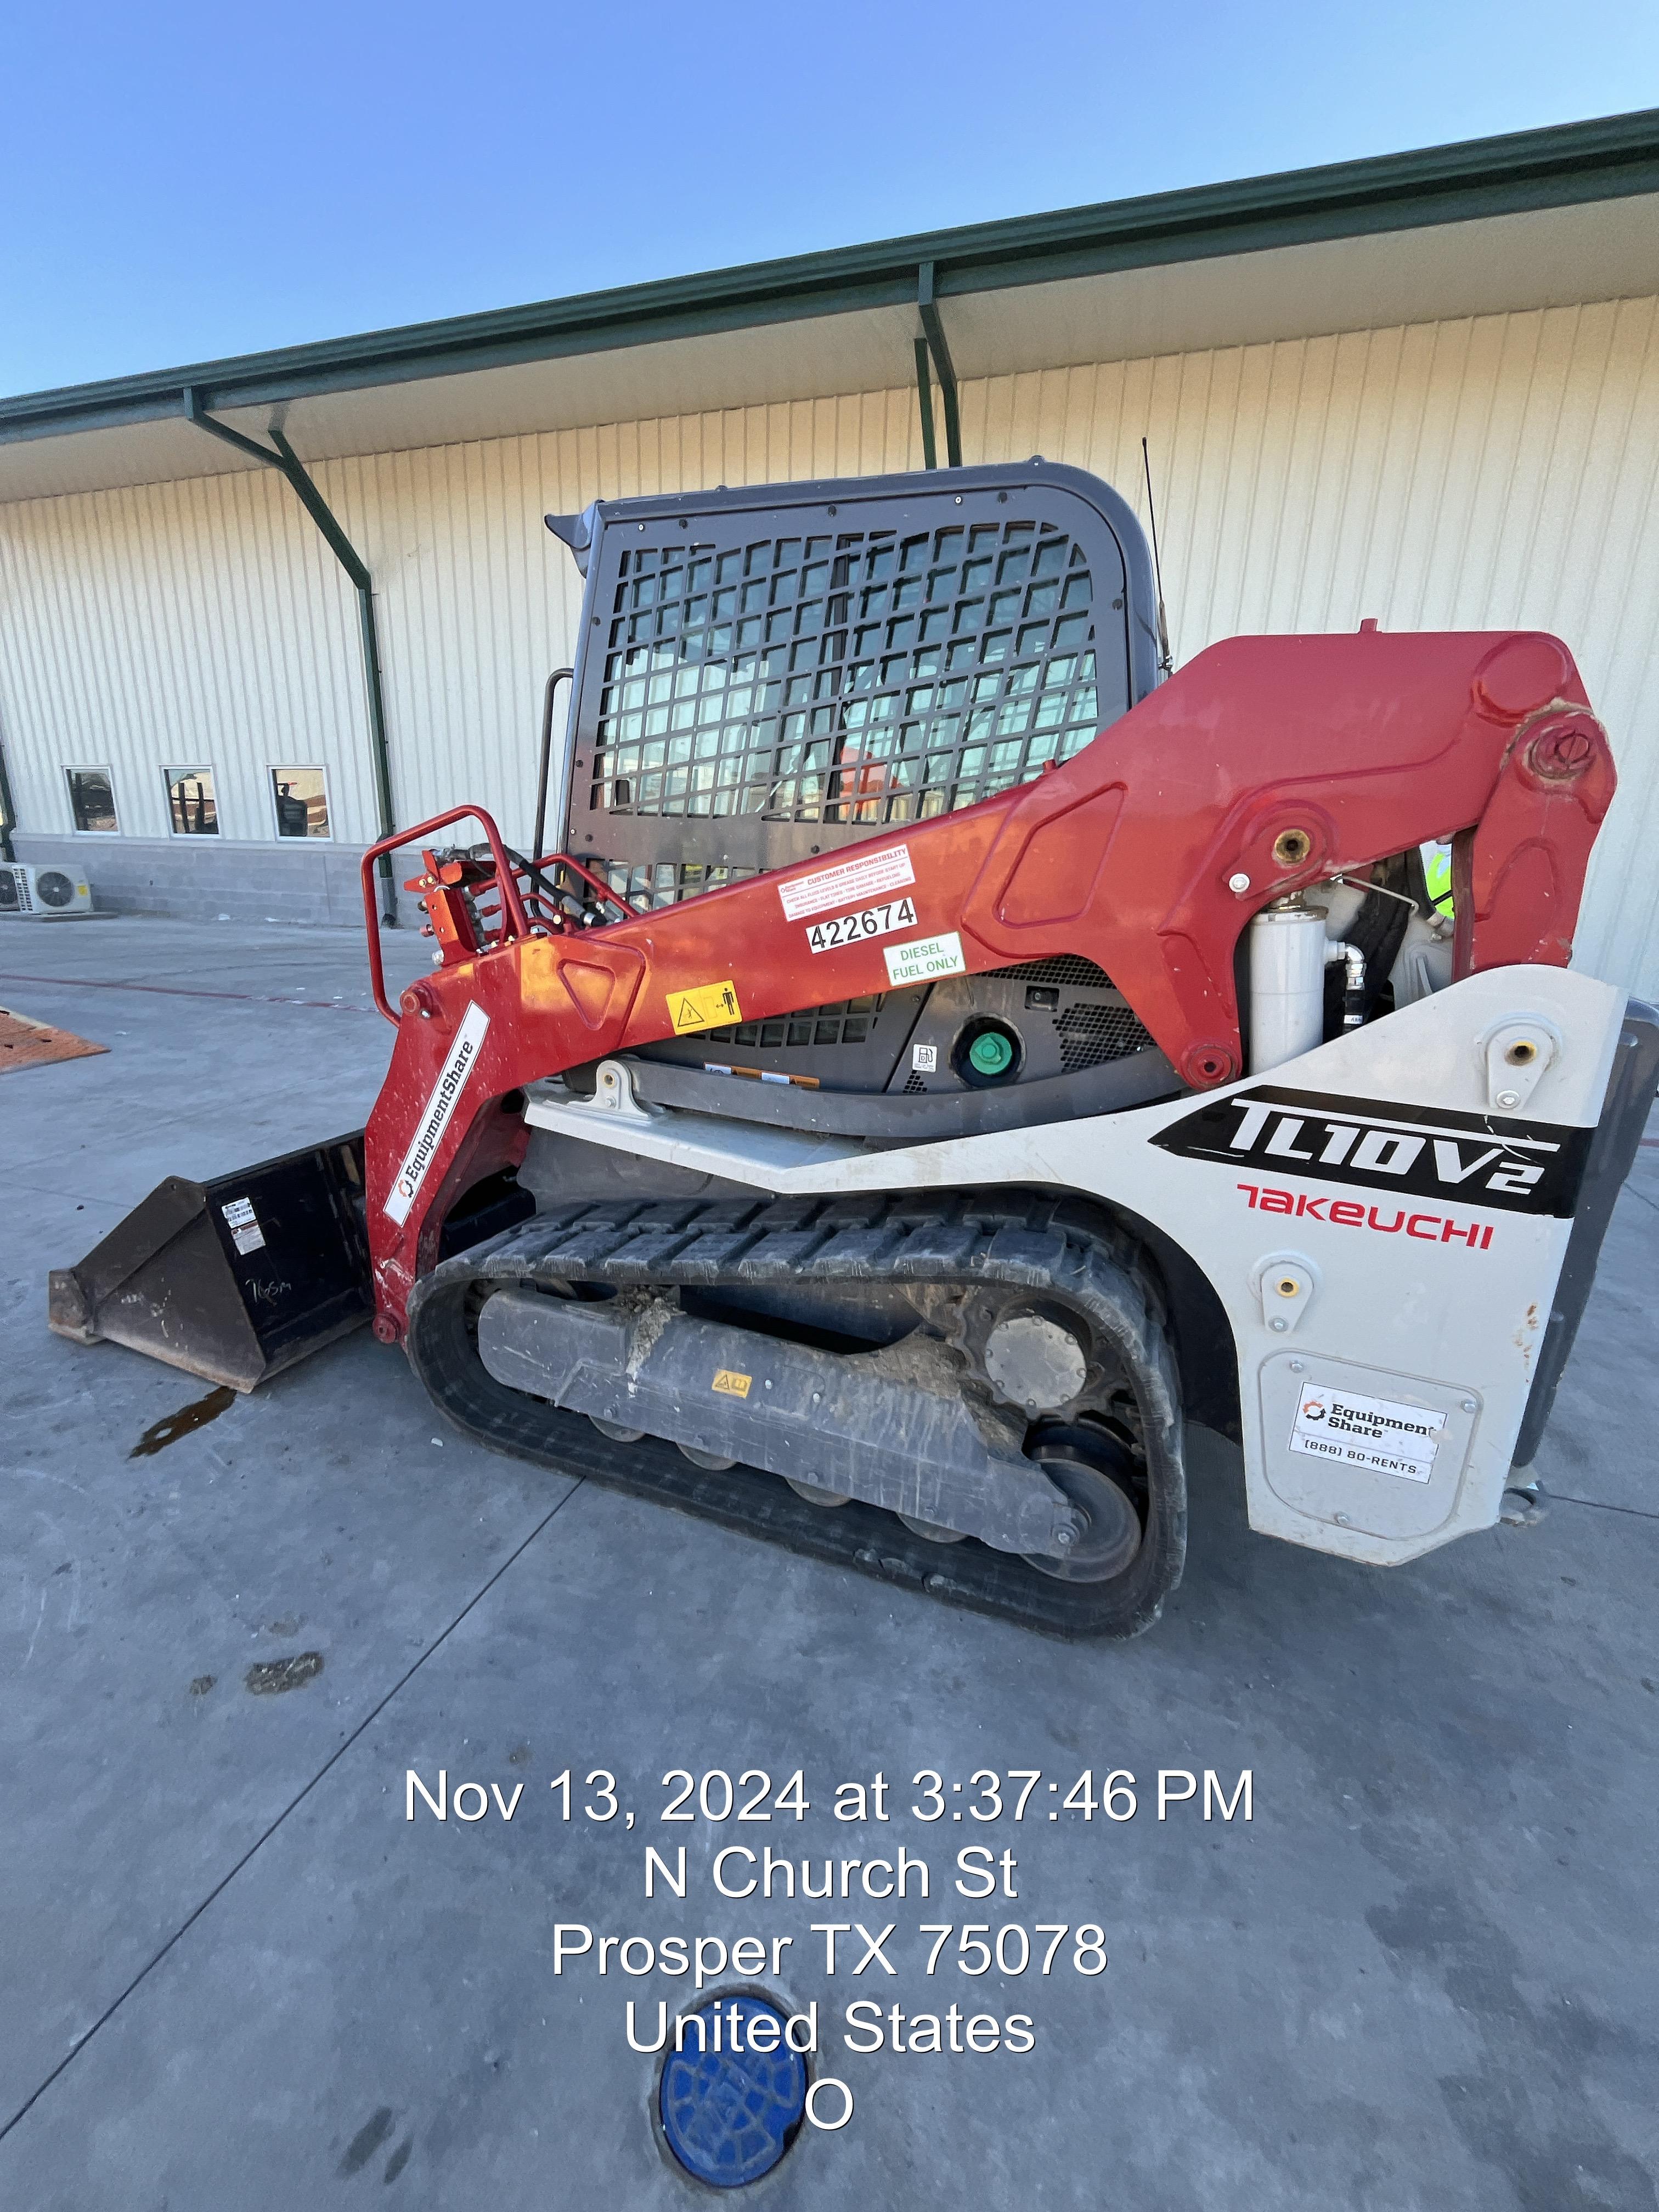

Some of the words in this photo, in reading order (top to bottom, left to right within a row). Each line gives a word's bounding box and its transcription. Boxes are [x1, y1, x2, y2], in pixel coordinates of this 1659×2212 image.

[807, 868, 845, 885] CUSTOMER
[845, 848, 907, 873] RESPONSIBILITY
[811, 899, 914, 948] 422674
[893, 967, 924, 980] FUEL
[927, 956, 958, 972] ONLY
[900, 943, 944, 961] DIESEL
[405, 1041, 473, 1181] EquipmentShare
[1328, 1417, 1383, 1438] Share
[1305, 1440, 1342, 1456] (888)
[1347, 1450, 1417, 1474] 80-RENTS
